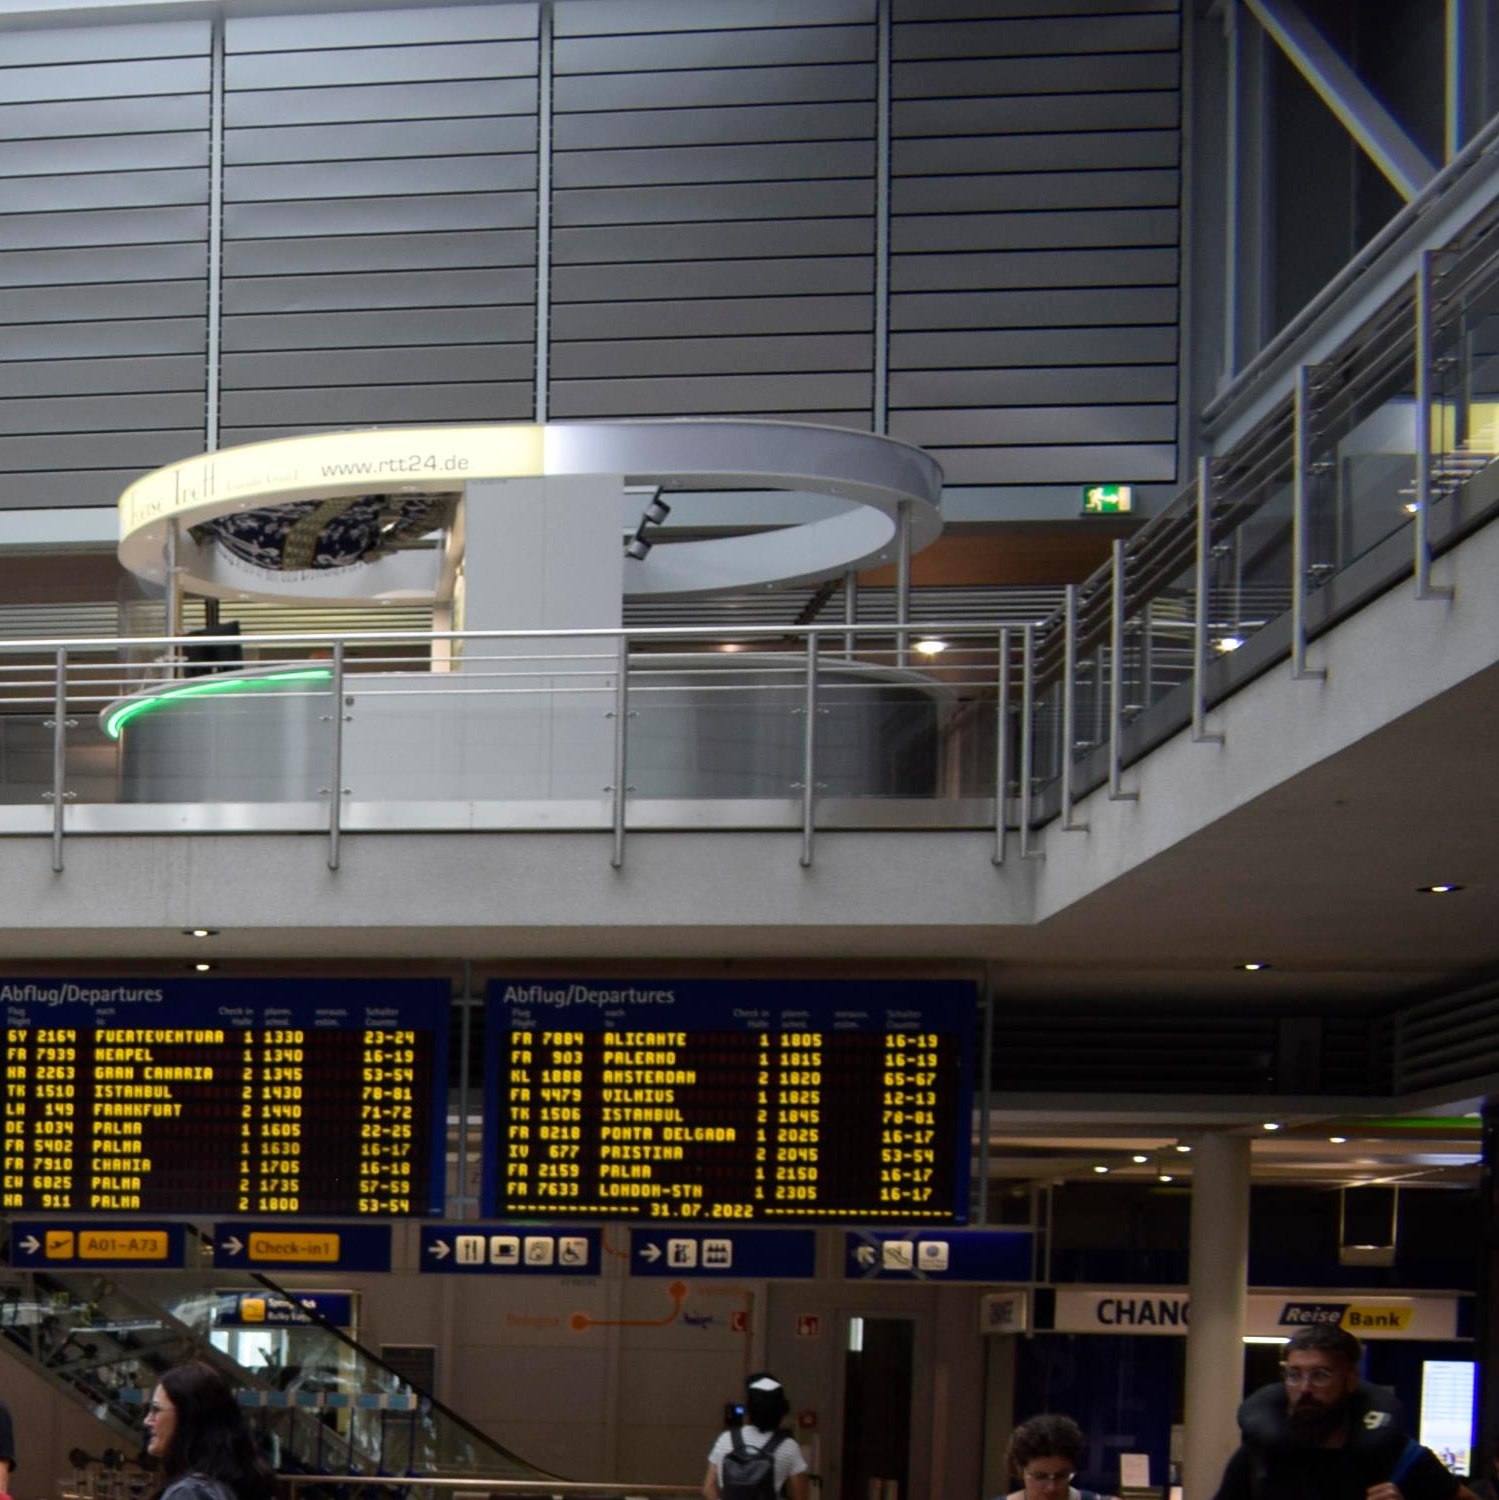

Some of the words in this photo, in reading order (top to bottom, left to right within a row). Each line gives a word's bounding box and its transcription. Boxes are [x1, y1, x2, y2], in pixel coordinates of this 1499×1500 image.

[321, 455, 470, 478] www.rtt24.de
[0, 984, 164, 1007] Abflug/Departures
[503, 985, 675, 1007] Abflug/Departures
[36, 1030, 77, 1045] 2164
[94, 1029, 225, 1045] FUERTEVENTURA
[263, 1030, 305, 1046] 1330
[602, 1032, 687, 1048] ALICANTE
[780, 1033, 823, 1049] 1805
[35, 1048, 76, 1063] 7939
[93, 1048, 154, 1064] NEAPEL
[263, 1049, 304, 1064] 1340
[602, 1051, 677, 1067] PALERMO
[779, 1052, 822, 1068] 1815
[35, 1066, 76, 1082] 2263
[93, 1066, 135, 1082] GRAN
[142, 1066, 214, 1082] CANARIA
[262, 1067, 304, 1083] 1345
[602, 1070, 697, 1086] AMSTERDAM
[779, 1072, 822, 1087] 1820
[35, 1084, 75, 1100] 1510
[94, 1085, 172, 1101] ISTANBUL
[261, 1086, 303, 1102] 1430
[601, 1089, 675, 1105] VILNIUS
[778, 1090, 821, 1106] 1825
[44, 1103, 75, 1118] 149
[92, 1103, 182, 1119] FRANKFURT
[261, 1105, 303, 1120] 1440
[602, 1107, 684, 1124] ISTANBUL
[778, 1110, 820, 1125] 1845
[34, 1121, 75, 1136] 1034
[92, 1121, 143, 1137] PALMA
[261, 1123, 301, 1139] 1605
[600, 1126, 654, 1142] PONTA
[662, 1127, 737, 1144] DELGADA
[776, 1128, 820, 1144] 2025
[33, 1139, 74, 1155] 5402
[91, 1139, 143, 1155] PALMA
[261, 1142, 301, 1157] 1630
[599, 1145, 684, 1162] PRISTINA
[776, 1148, 819, 1163] 2045
[32, 1157, 74, 1173] 7910
[91, 1158, 152, 1174] CHANIA
[259, 1160, 300, 1176] 1705
[598, 1164, 652, 1180] PALMA
[775, 1167, 819, 1183] 2150
[32, 1176, 72, 1191] 6825
[90, 1176, 142, 1192] PALMA
[259, 1179, 300, 1194] 1735
[598, 1183, 703, 1200] LONDON-STN
[775, 1186, 818, 1202] 2305
[41, 1194, 72, 1210] 911
[90, 1195, 141, 1210] PALMA
[258, 1197, 300, 1213] 1800
[651, 1203, 754, 1220] 31.07.2022
[1283, 1304, 1344, 1325] Reise
[1348, 1310, 1401, 1327] Bank
